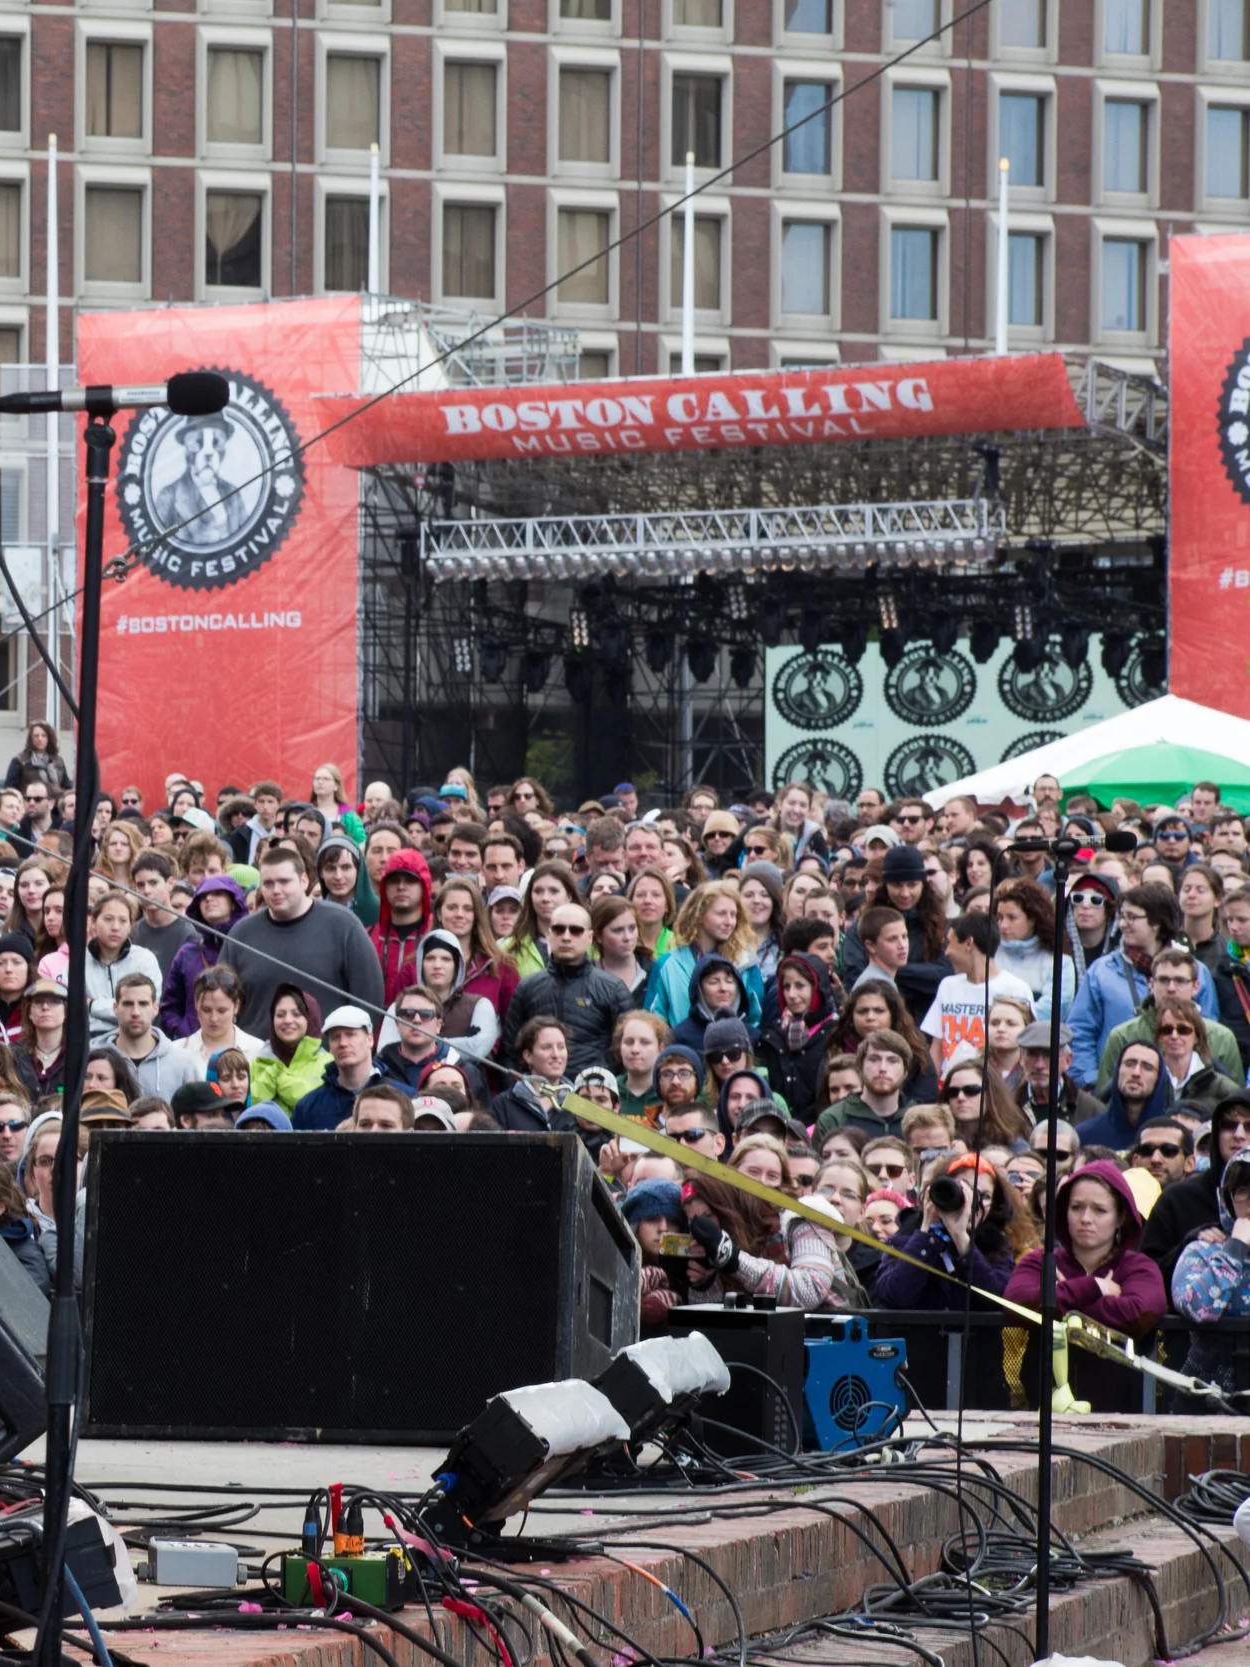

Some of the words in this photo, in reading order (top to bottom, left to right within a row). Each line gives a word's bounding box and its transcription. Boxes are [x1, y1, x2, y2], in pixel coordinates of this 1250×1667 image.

[124, 406, 170, 478] BOST
[228, 380, 295, 471] LLING
[439, 395, 656, 434] BOSTON
[666, 378, 934, 423] CALLING
[512, 430, 646, 453] MUSIC
[664, 416, 876, 446] FESTIVAL
[190, 500, 290, 577] FESTIVAL
[116, 610, 302, 636] #BOSTONCALLING
